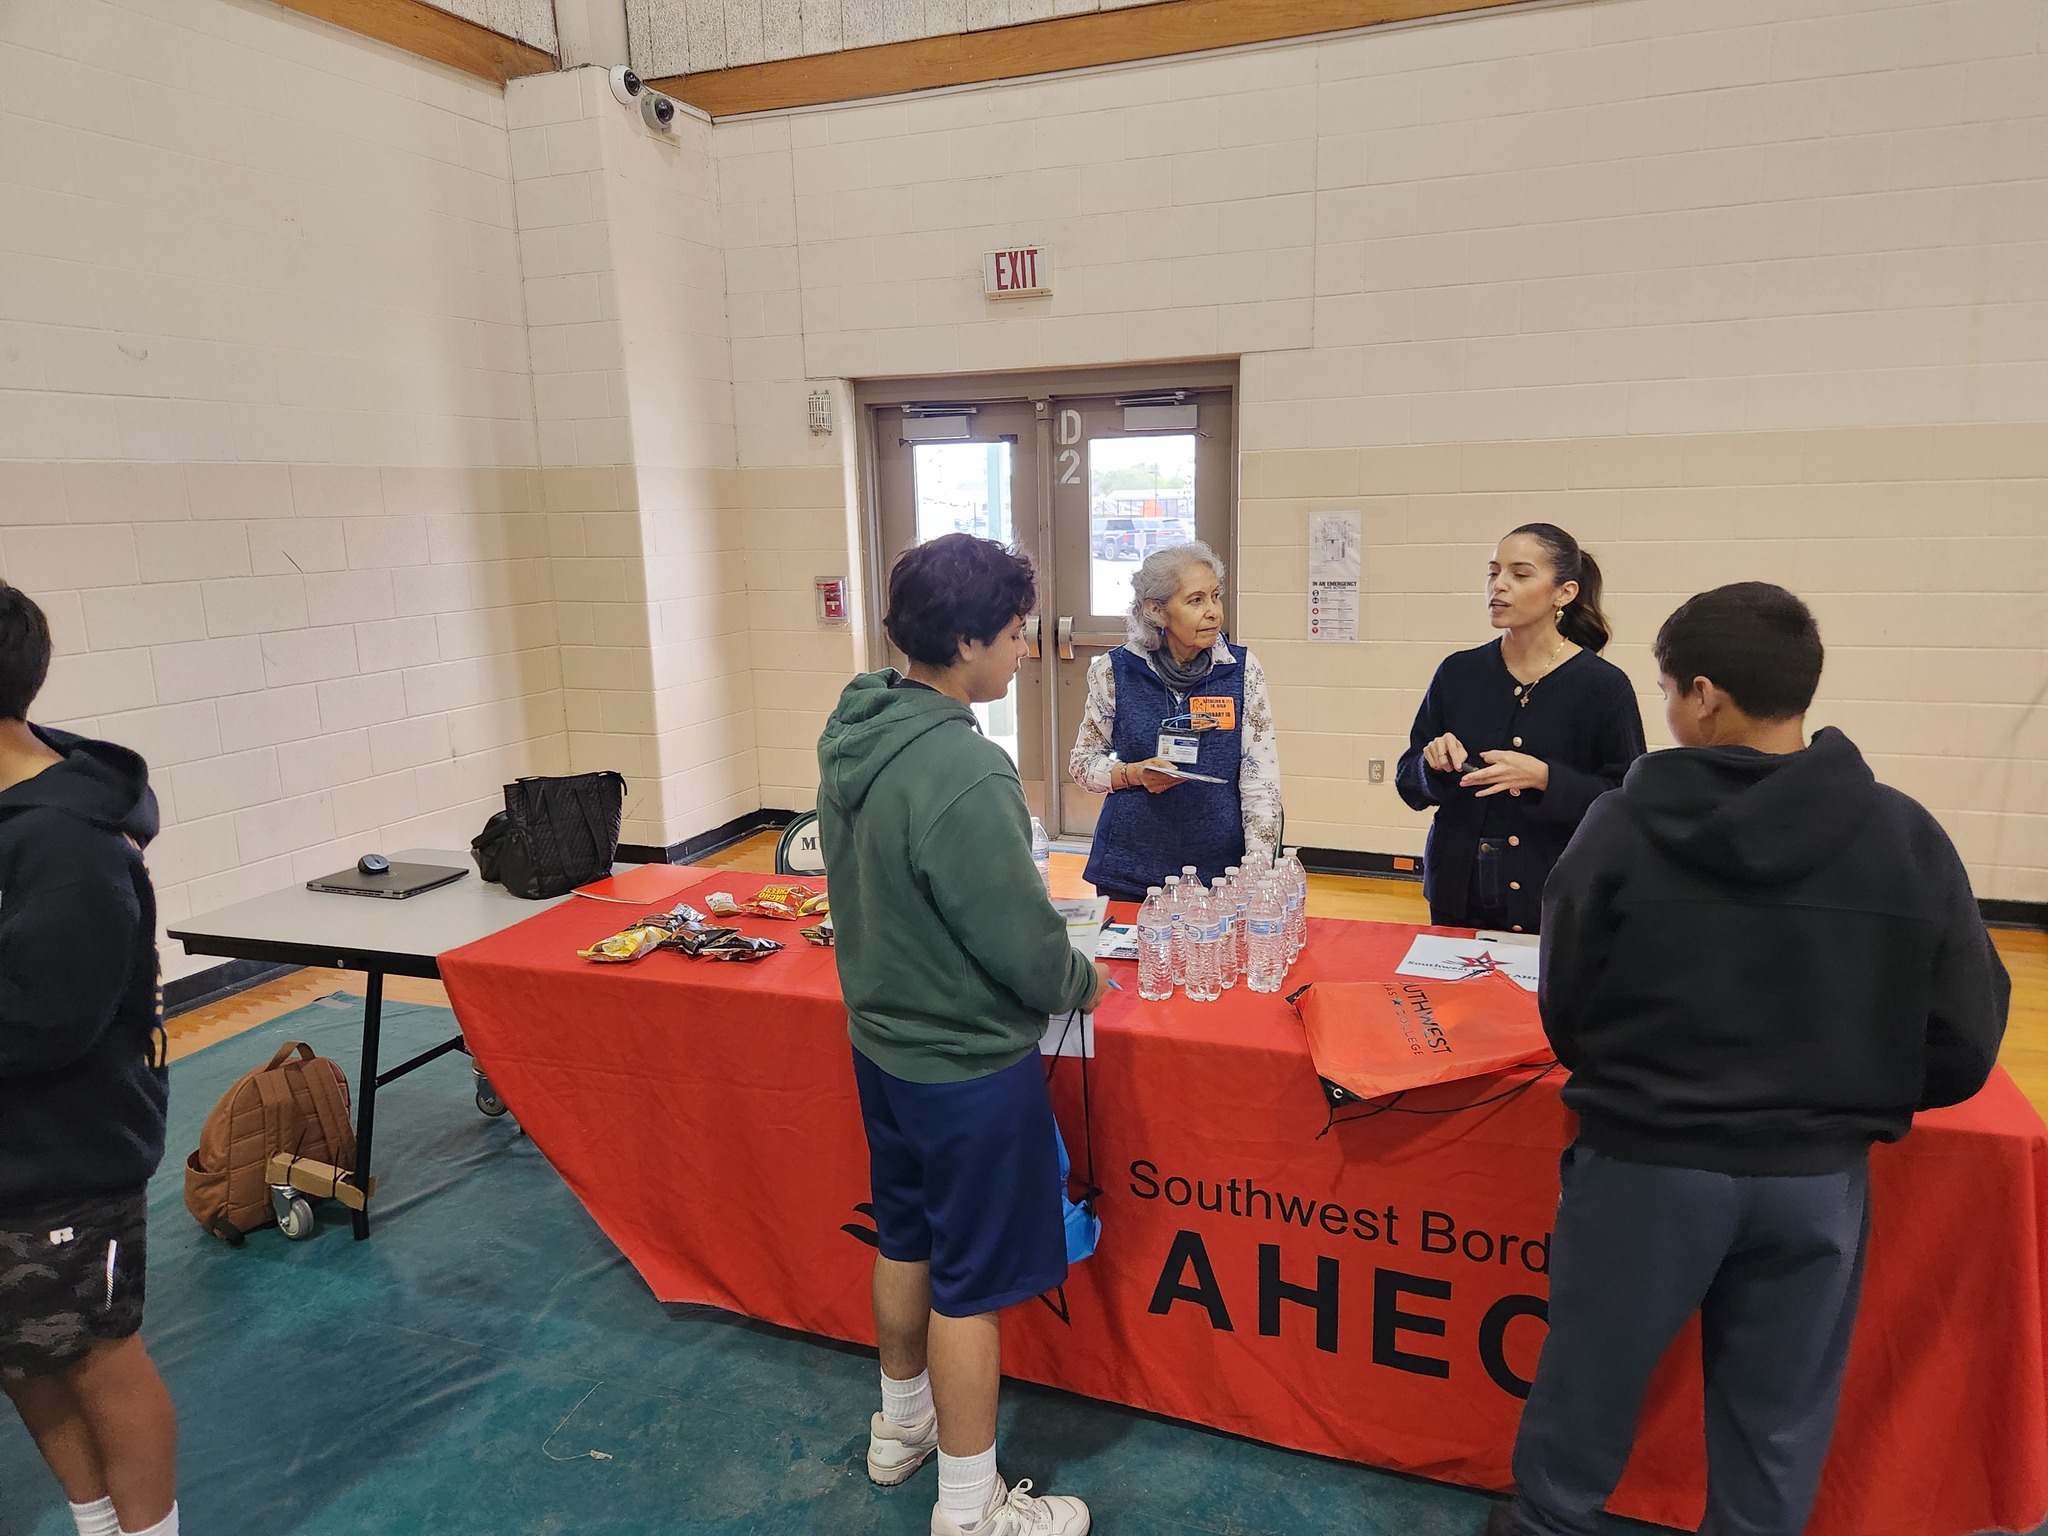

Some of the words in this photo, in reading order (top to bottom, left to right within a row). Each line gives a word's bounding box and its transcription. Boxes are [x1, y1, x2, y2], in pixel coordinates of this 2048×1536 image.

[995, 249, 1038, 291] EXIT
[1060, 409, 1082, 445] D
[1060, 449, 1081, 484] 2
[1407, 960, 1469, 972] Southwest
[1130, 1160, 1399, 1247] Southwest
[1421, 1209, 1552, 1276] Bord
[1147, 1229, 1552, 1401] AHEC
